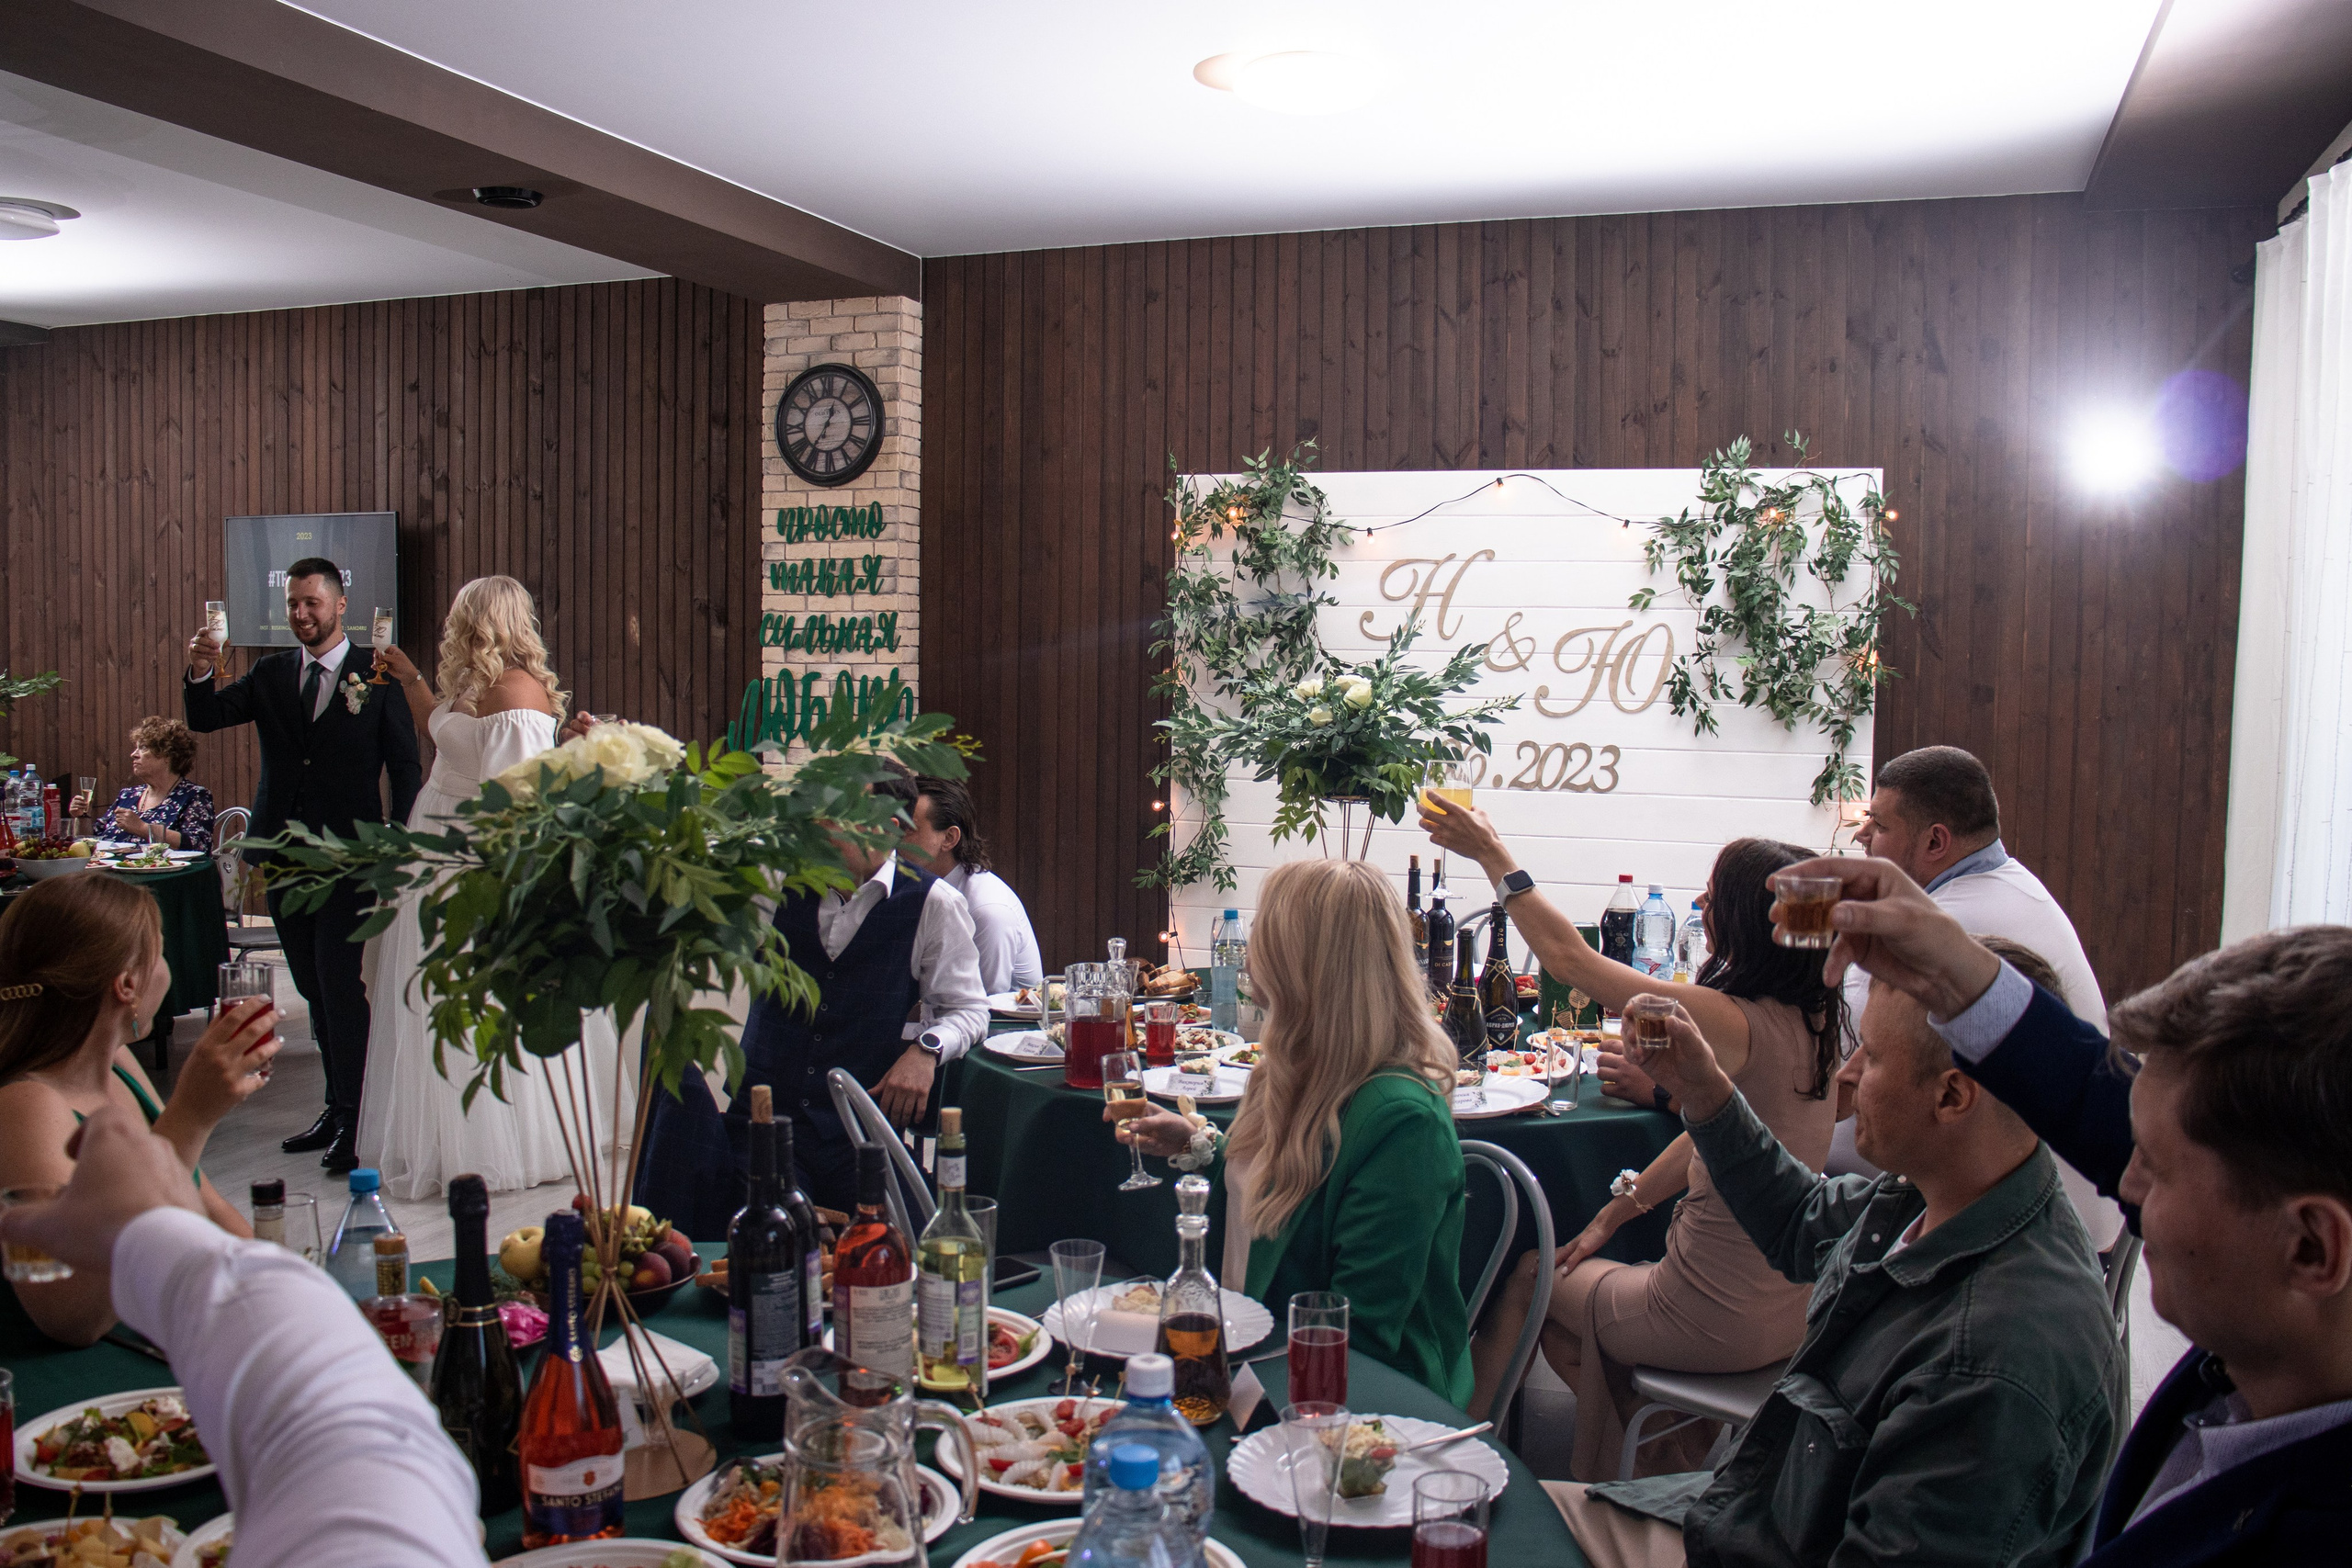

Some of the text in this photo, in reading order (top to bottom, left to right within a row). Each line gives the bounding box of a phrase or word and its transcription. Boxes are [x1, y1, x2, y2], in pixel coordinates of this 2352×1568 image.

[296, 532, 312, 540] 2023
[1484, 612, 1536, 672] &
[1533, 620, 1675, 718] Ю
[541, 1495, 582, 1507] SANTO
